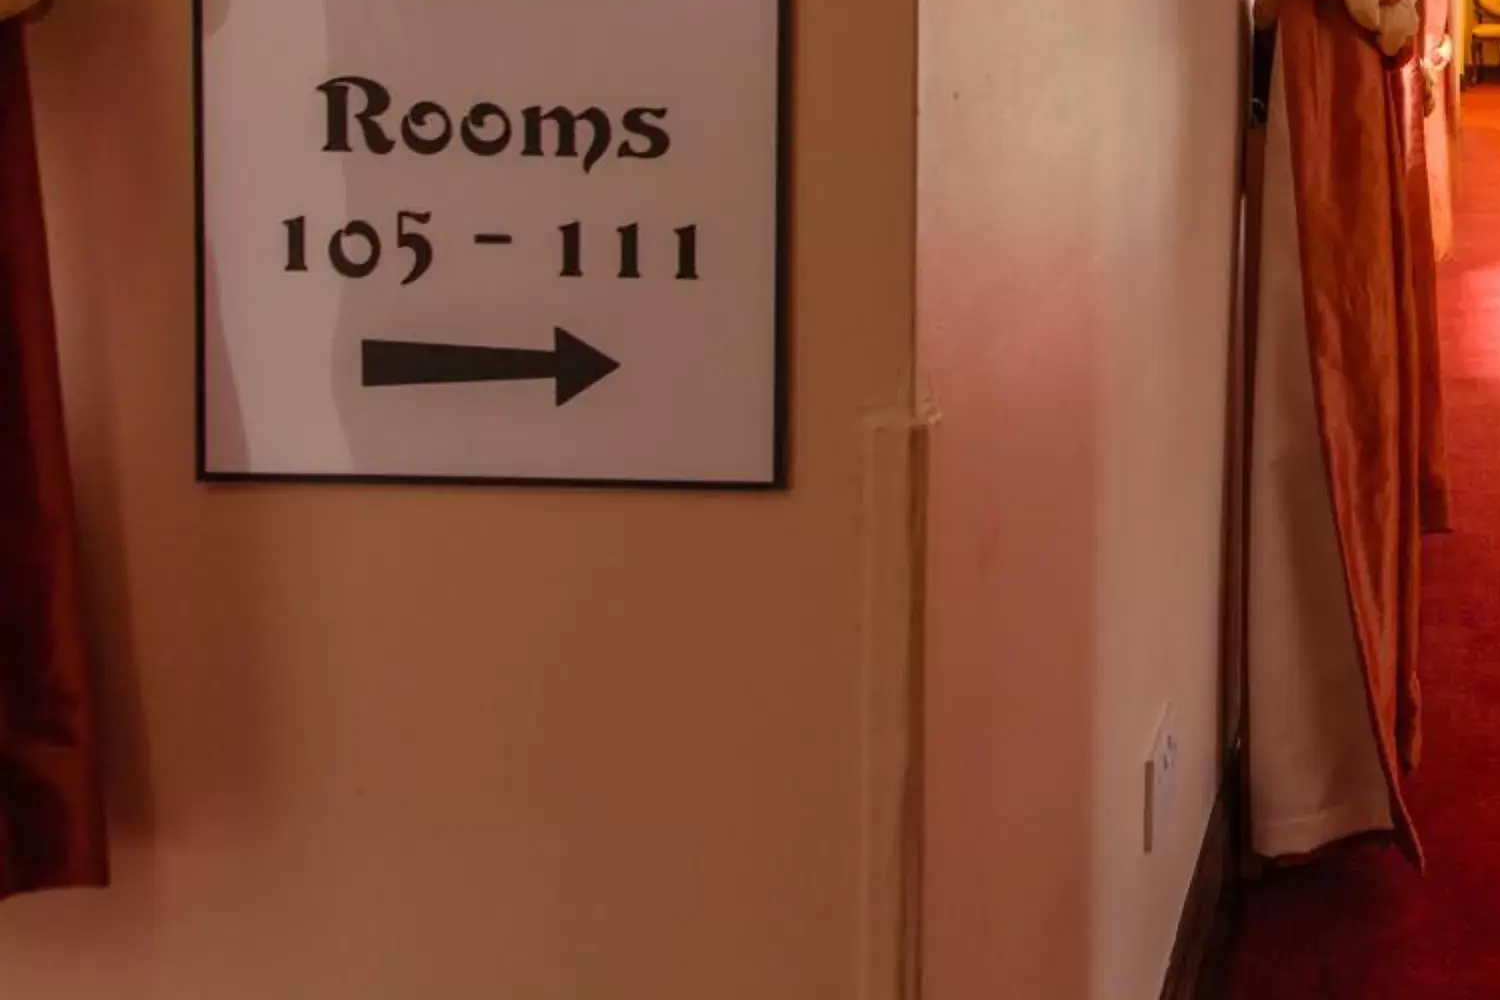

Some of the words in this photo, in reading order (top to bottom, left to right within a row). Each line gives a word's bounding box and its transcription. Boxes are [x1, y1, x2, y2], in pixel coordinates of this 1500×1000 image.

[315, 75, 671, 174] Rooms
[281, 210, 433, 286] 105
[558, 220, 699, 281] 111
